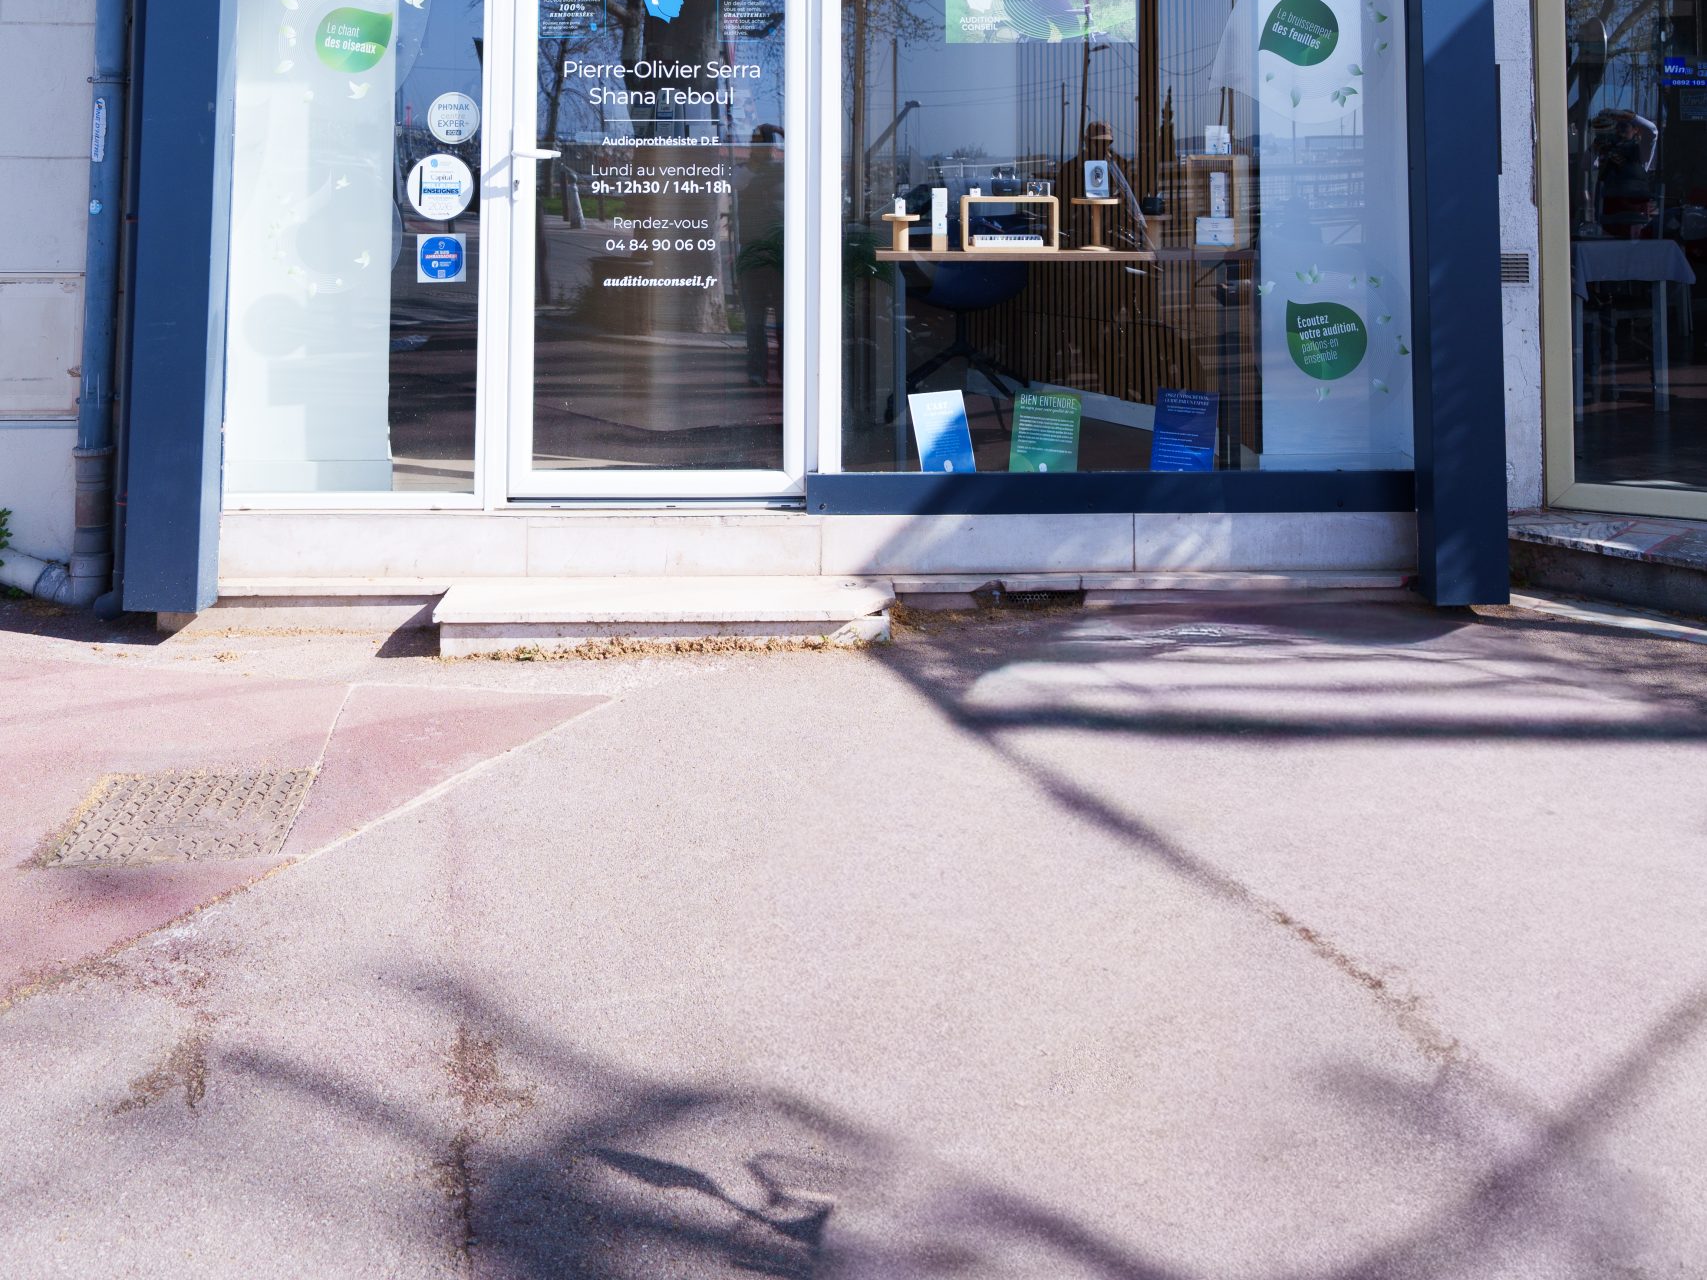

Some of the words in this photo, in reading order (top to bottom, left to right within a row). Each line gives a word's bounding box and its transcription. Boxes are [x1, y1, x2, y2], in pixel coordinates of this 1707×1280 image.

[559, 3, 585, 11] 100%
[959, 16, 1001, 24] AUDITION
[961, 23, 998, 31] CONSEIL
[1276, 7, 1287, 19] Le
[1287, 11, 1332, 40] bruissement
[326, 22, 336, 34] Le
[337, 23, 361, 38] chant
[1272, 21, 1288, 36] des
[1288, 27, 1321, 50] feuilles
[325, 36, 340, 49] des
[342, 39, 377, 55] oiseaux
[563, 60, 702, 79] Pierre-Olivier
[706, 61, 761, 79] Serra
[589, 87, 656, 106] Shana
[662, 87, 734, 106] Teboul
[437, 103, 470, 111] PHONAK
[440, 112, 466, 120] centre
[437, 119, 469, 128] EXPER
[602, 135, 698, 148] Audioprothésiste
[701, 136, 722, 146] D.E.
[591, 163, 633, 176] Lundi
[637, 166, 656, 176] au
[659, 163, 725, 176] vendredi
[422, 187, 460, 195] ENSEIGNES
[591, 181, 660, 194] 9h-12h30
[663, 181, 669, 195] /
[673, 181, 732, 194] 14h-18h
[613, 217, 709, 229] Rendez-vous
[605, 239, 625, 251] 04
[628, 239, 648, 251] 84
[652, 239, 671, 251] 90
[674, 239, 693, 251] 06
[697, 239, 716, 251] 09
[603, 276, 718, 290] auditionconseil.fr
[1297, 314, 1329, 329] Écoutez
[1299, 327, 1321, 341] votre
[1322, 321, 1359, 338] audition,
[1302, 337, 1339, 353] parlons-en
[1304, 350, 1338, 365] ensemble
[1020, 393, 1037, 405] BIEN
[1039, 395, 1075, 409] ENTENDRE
